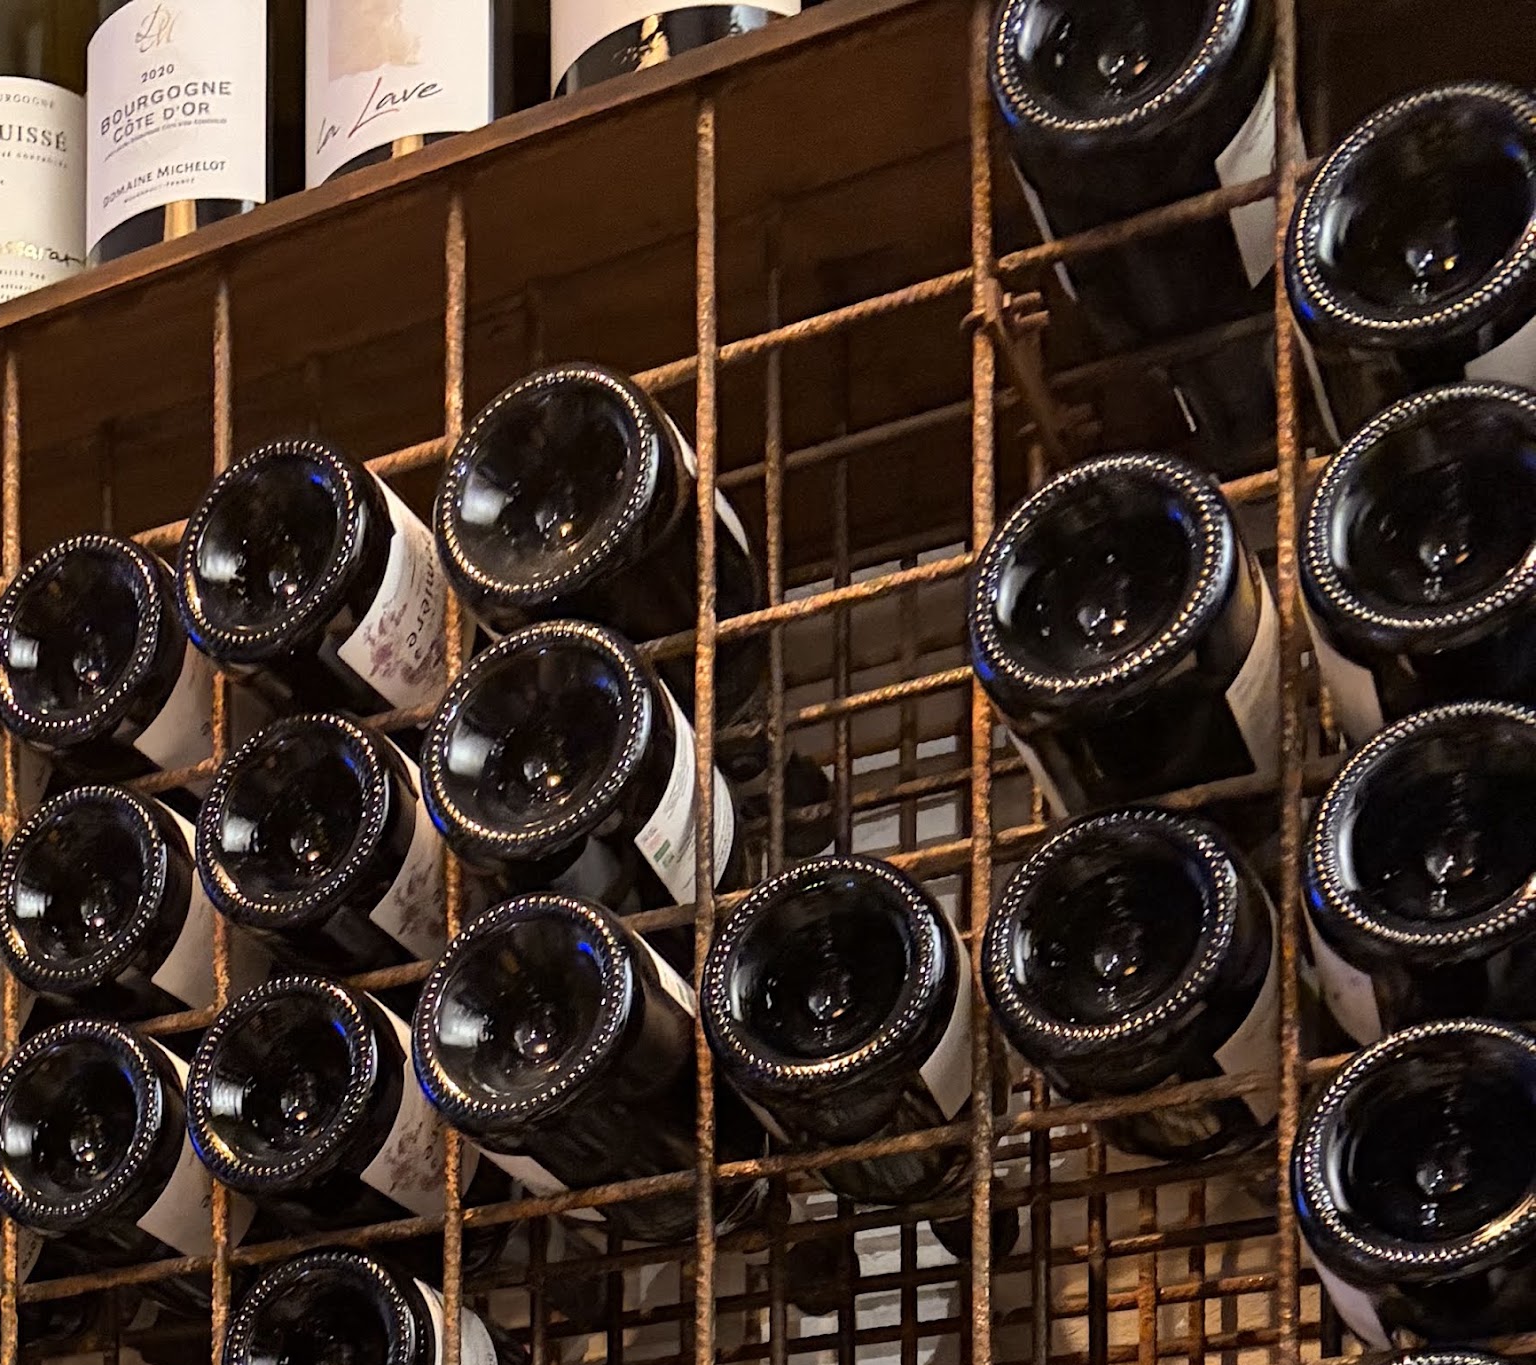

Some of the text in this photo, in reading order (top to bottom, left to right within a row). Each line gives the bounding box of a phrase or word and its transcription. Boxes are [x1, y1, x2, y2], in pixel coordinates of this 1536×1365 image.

[141, 63, 175, 83] 2020
[100, 80, 233, 136] BOURGOGNE
[112, 111, 155, 144] CÔTE
[163, 101, 211, 121] D'OR
[102, 160, 227, 209] DOMAINE MICHELOT
